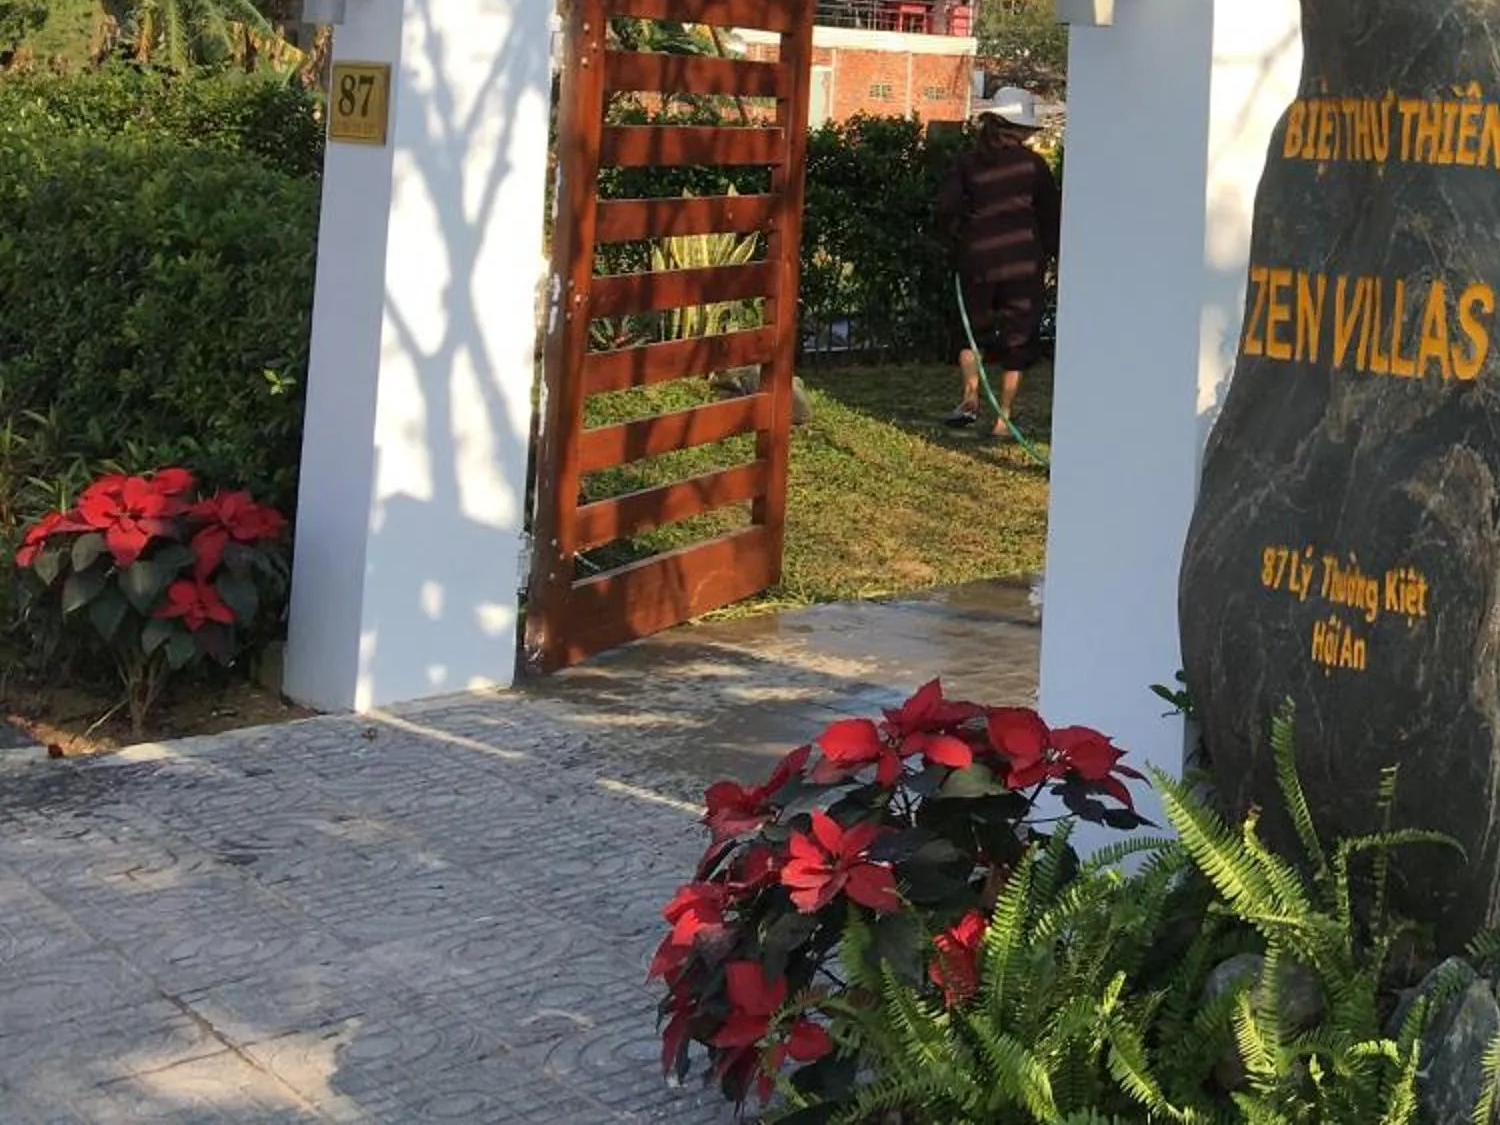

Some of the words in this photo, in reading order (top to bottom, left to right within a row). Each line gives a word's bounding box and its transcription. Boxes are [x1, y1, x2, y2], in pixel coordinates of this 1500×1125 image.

[338, 74, 375, 118] 87
[1244, 267, 1326, 363] ZEN
[1332, 273, 1496, 380] VILLAS
[1261, 546, 1287, 589] 87
[1288, 544, 1313, 602] Lý
[1340, 626, 1366, 671] An
